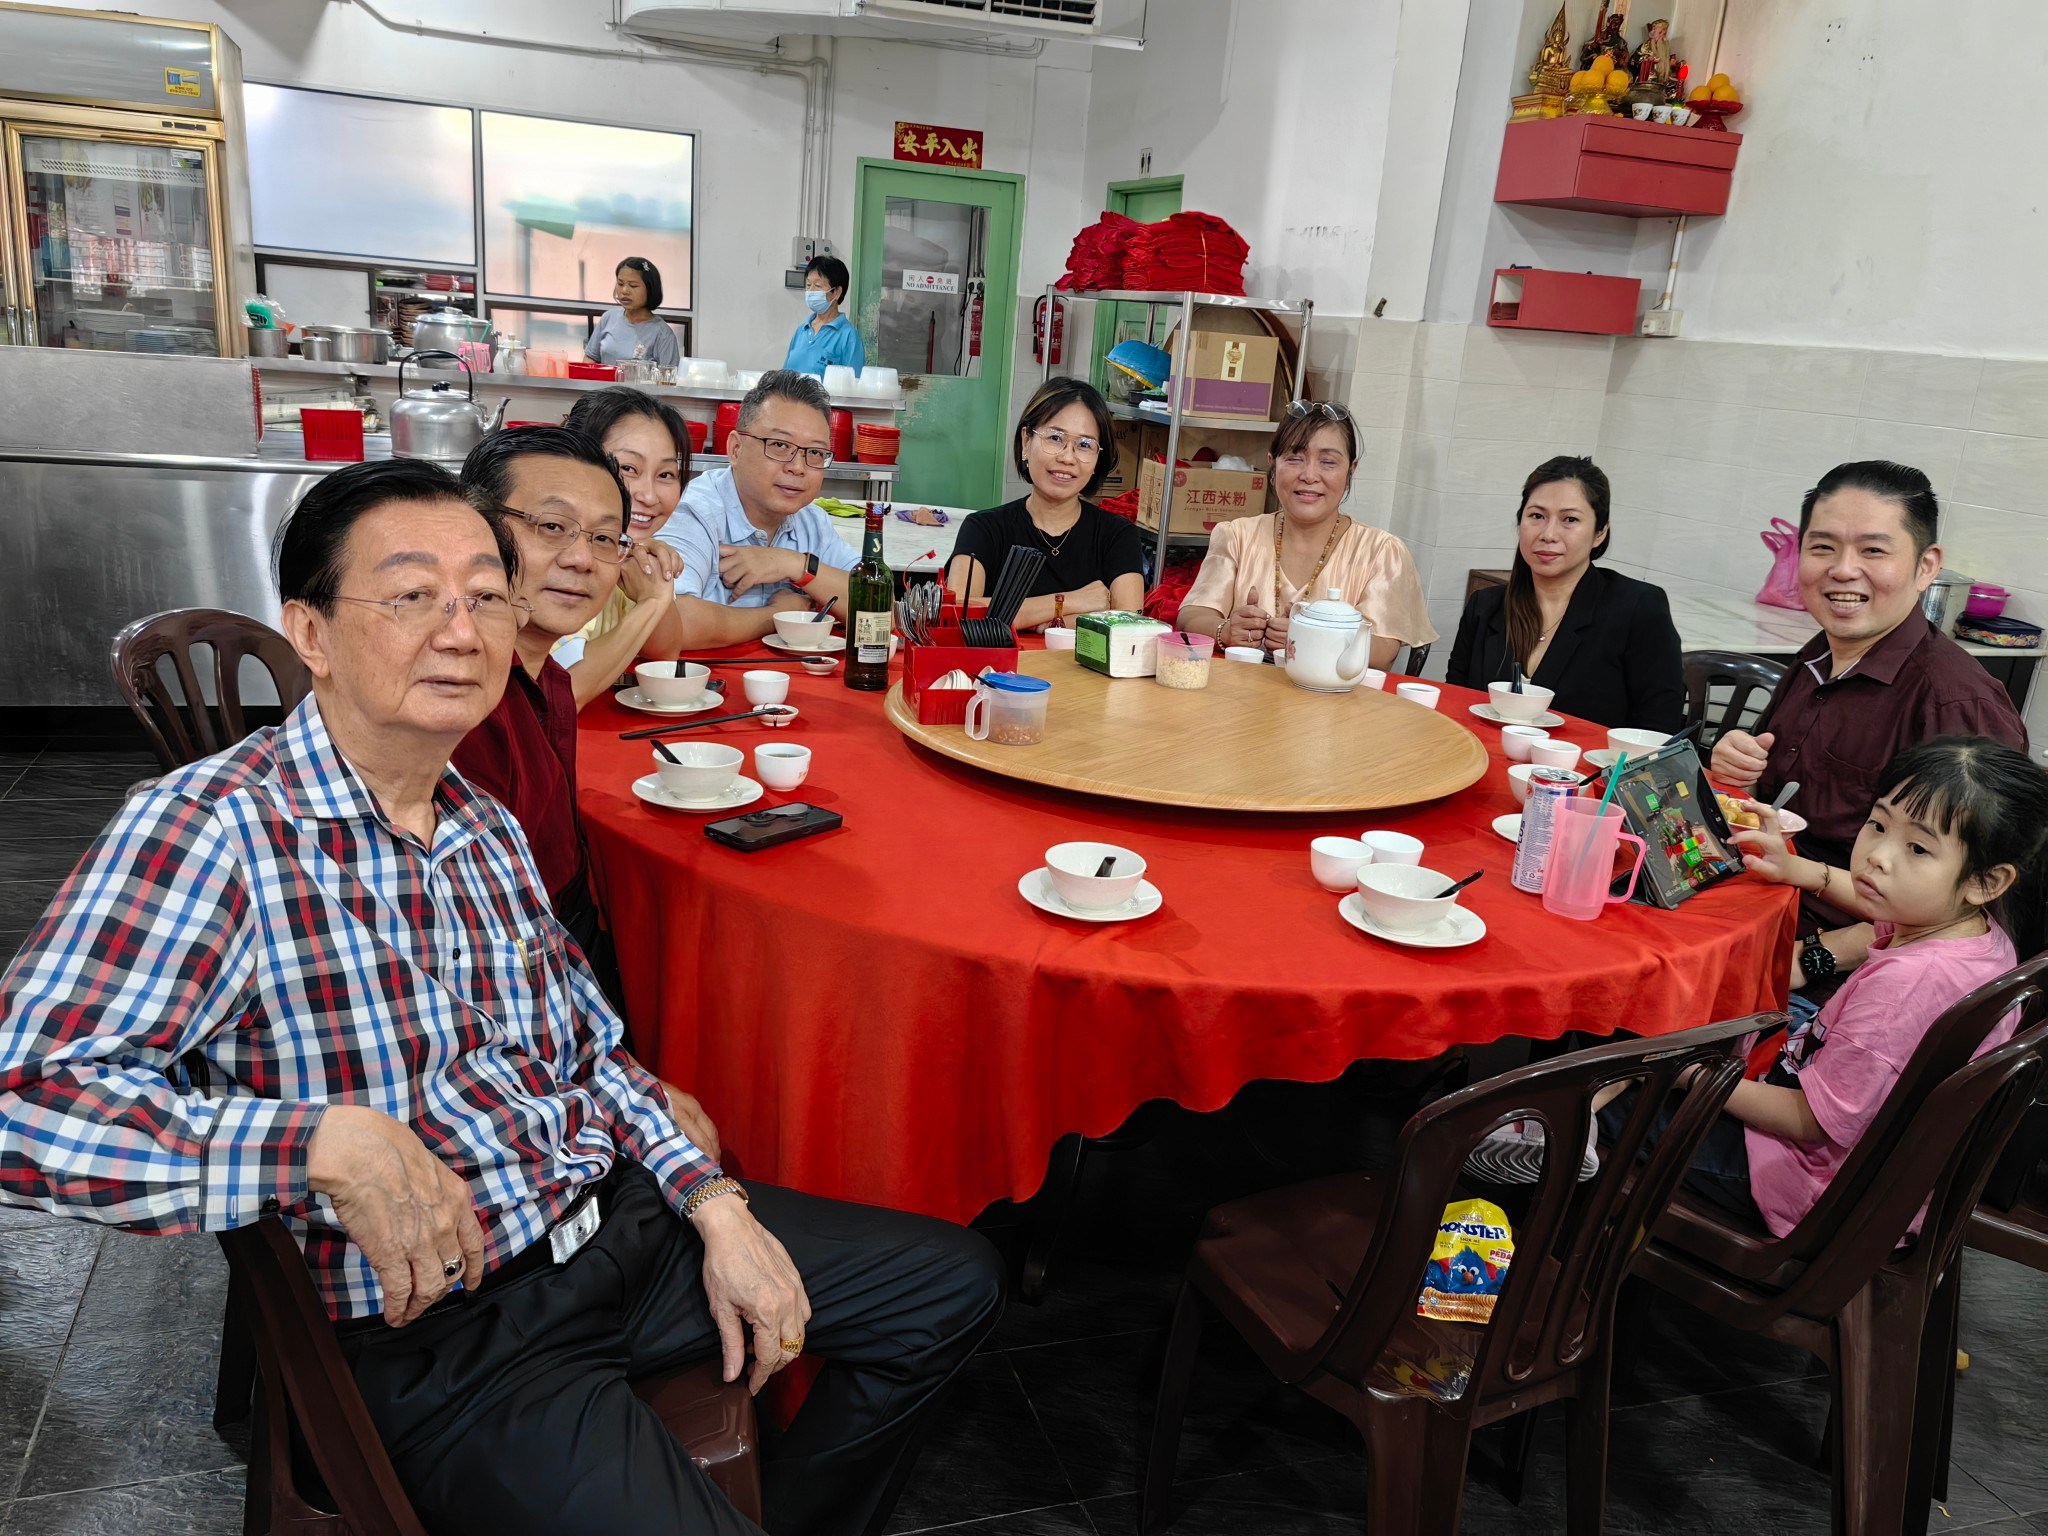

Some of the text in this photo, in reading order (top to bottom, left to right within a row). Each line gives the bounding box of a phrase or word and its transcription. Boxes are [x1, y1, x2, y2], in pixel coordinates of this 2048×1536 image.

[916, 283, 955, 292] ADMITTANCE
[1186, 489, 1247, 507] 江西米粉
[1489, 1250, 1512, 1261] PEDA
